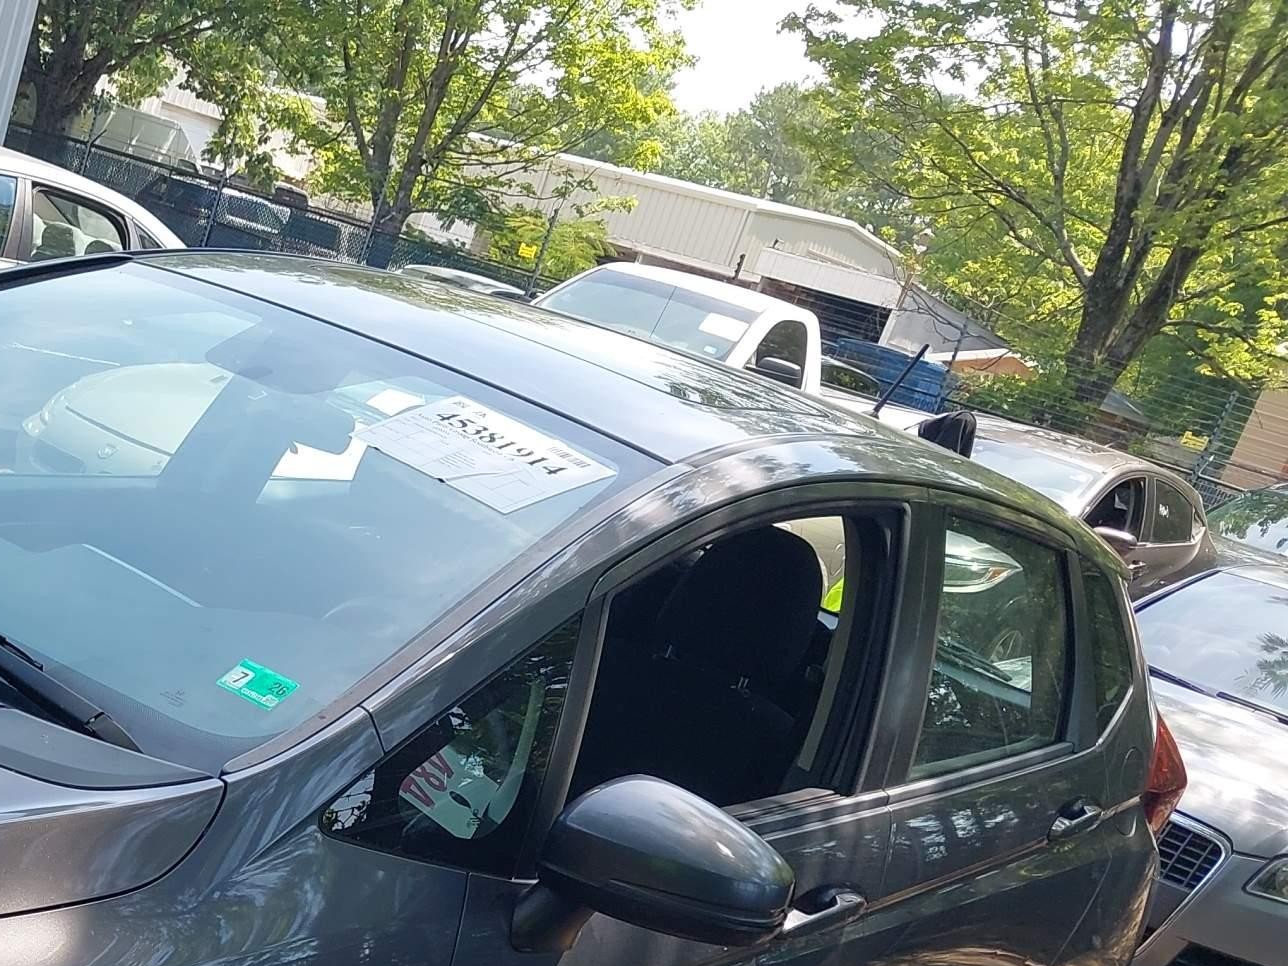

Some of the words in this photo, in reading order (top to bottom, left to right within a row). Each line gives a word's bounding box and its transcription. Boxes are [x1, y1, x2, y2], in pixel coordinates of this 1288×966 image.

[436, 413, 568, 475] 45381914
[232, 671, 250, 684] 7
[268, 682, 288, 696] 26
